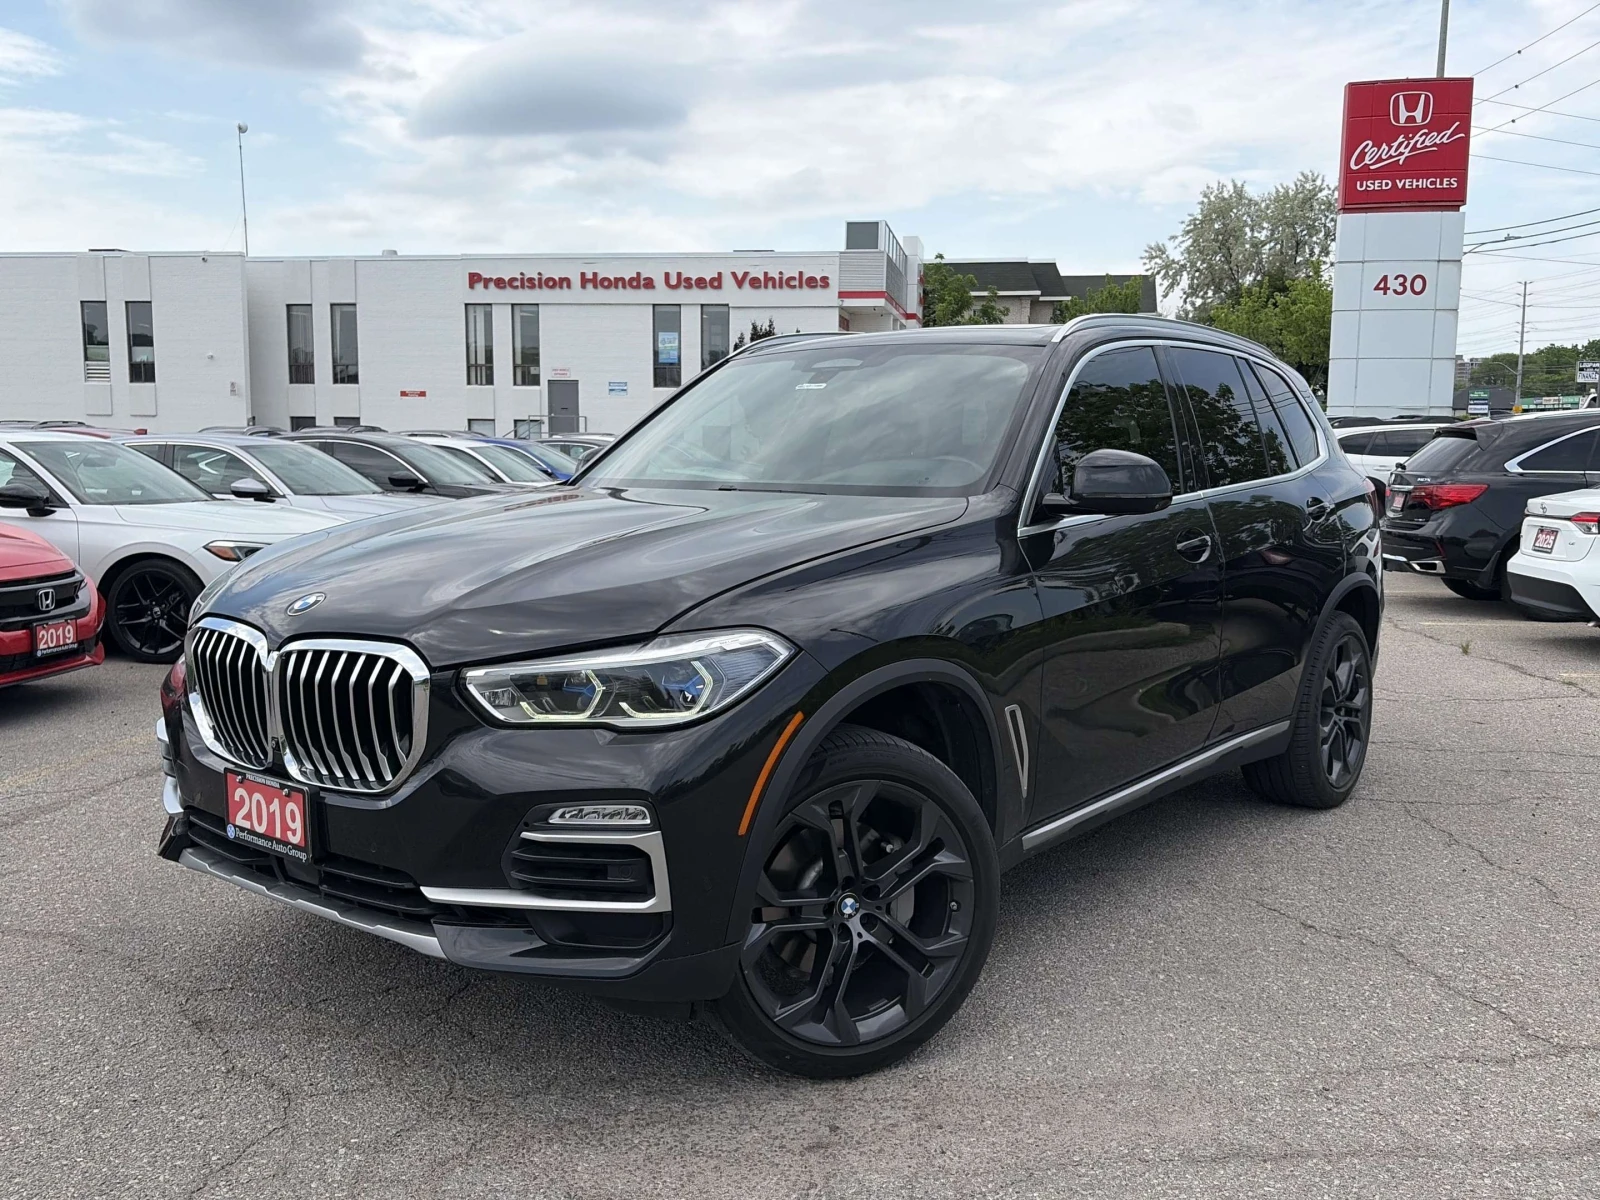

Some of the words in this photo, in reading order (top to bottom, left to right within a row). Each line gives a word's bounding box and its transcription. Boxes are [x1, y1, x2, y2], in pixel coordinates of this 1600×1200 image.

[1350, 121, 1465, 170] Certified
[1356, 179, 1392, 191] USED
[1396, 177, 1458, 189] VEHICLES
[467, 272, 571, 290] Precision
[580, 272, 656, 290] Honda
[664, 271, 723, 290] Used
[730, 271, 830, 289] Vehicles
[1373, 274, 1427, 296] 430
[1534, 534, 1555, 549] 2025
[39, 625, 74, 649] 2019
[246, 773, 265, 783] PRECISION
[266, 780, 280, 788] HONDA
[234, 787, 302, 844] 2019
[236, 828, 271, 847] Performance
[272, 841, 287, 853] Auto
[287, 846, 307, 861] Group
